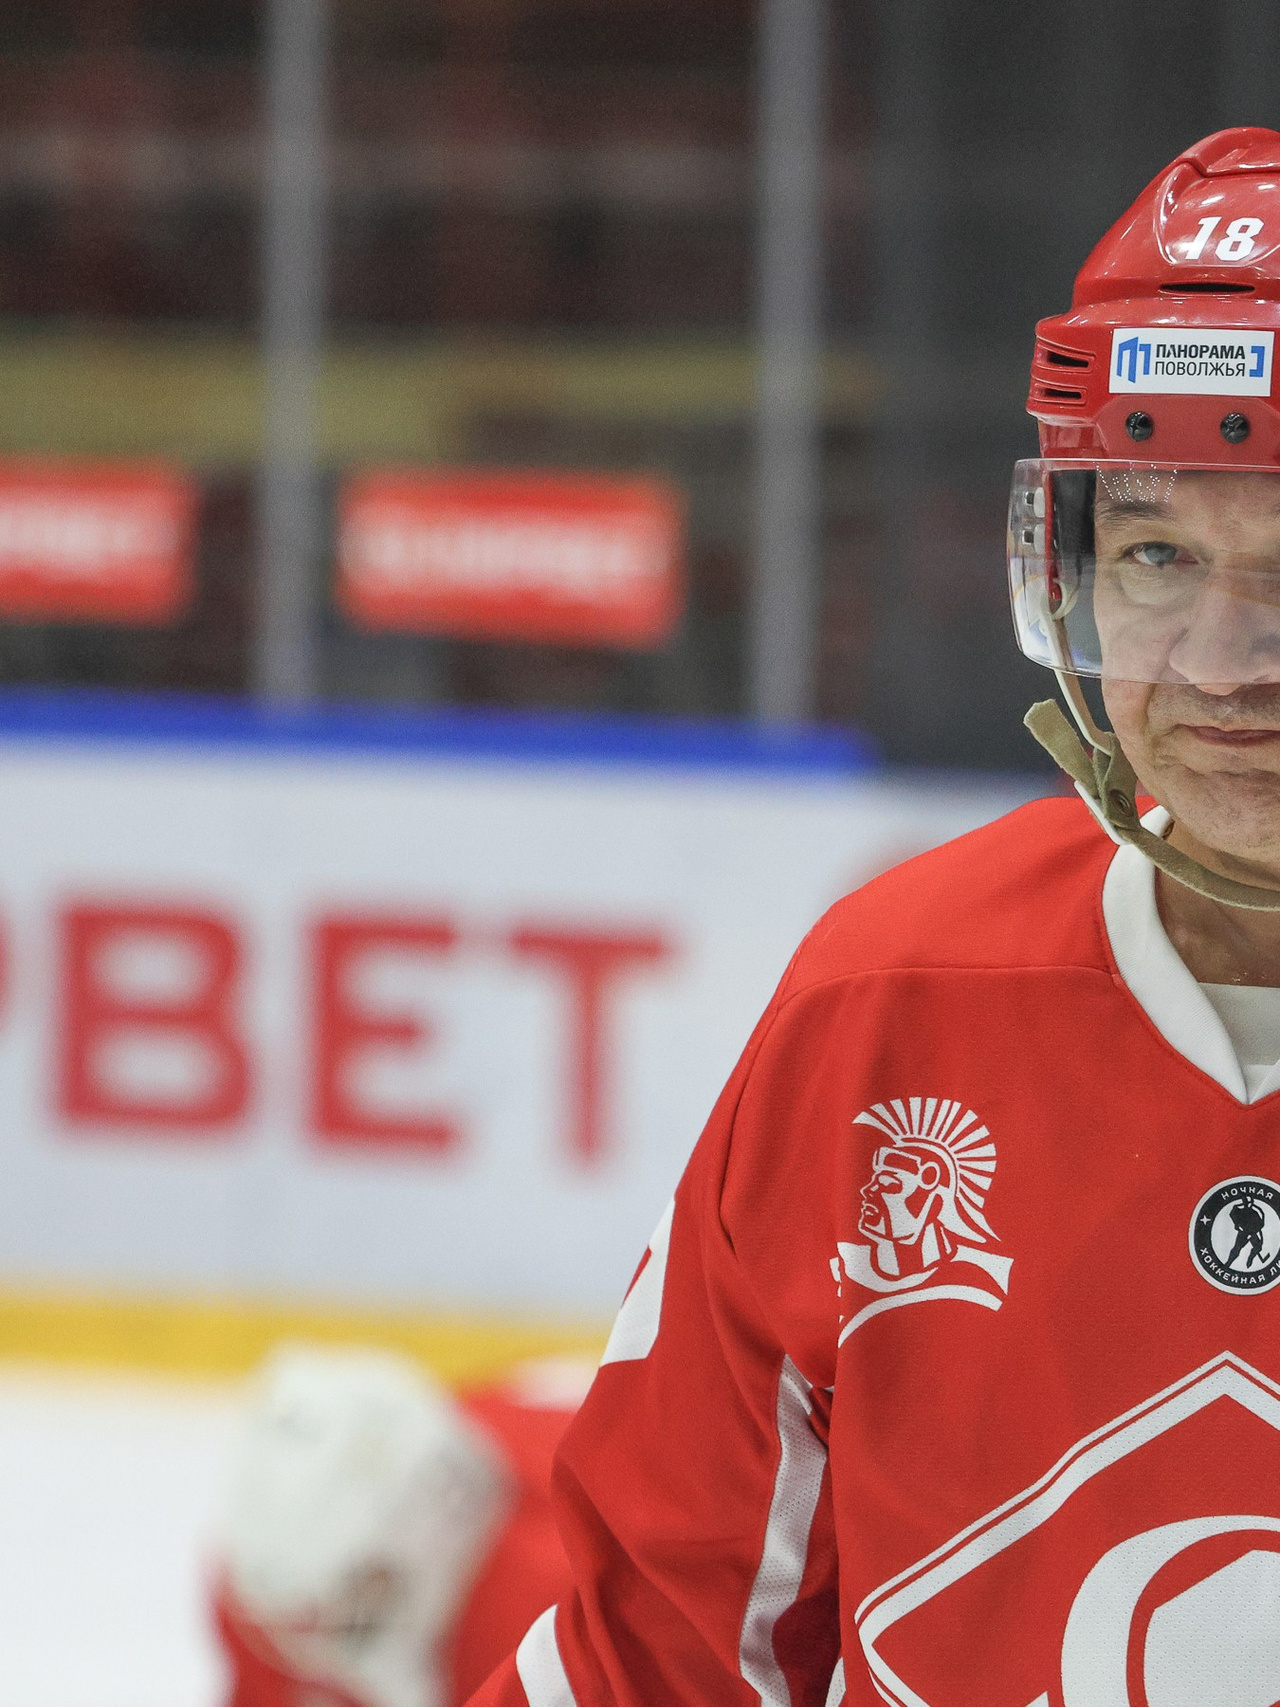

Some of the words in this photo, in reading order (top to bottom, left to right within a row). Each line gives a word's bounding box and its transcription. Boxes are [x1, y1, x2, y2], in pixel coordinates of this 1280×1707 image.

[1184, 216, 1264, 261] 18
[1156, 344, 1246, 359] ПАНОРАМА
[1155, 361, 1246, 377] ПОВОЛЖЬЯ
[1221, 1186, 1274, 1201] НОЧНАЯ
[1200, 1247, 1266, 1285] ХОККЕЙНАЯ
